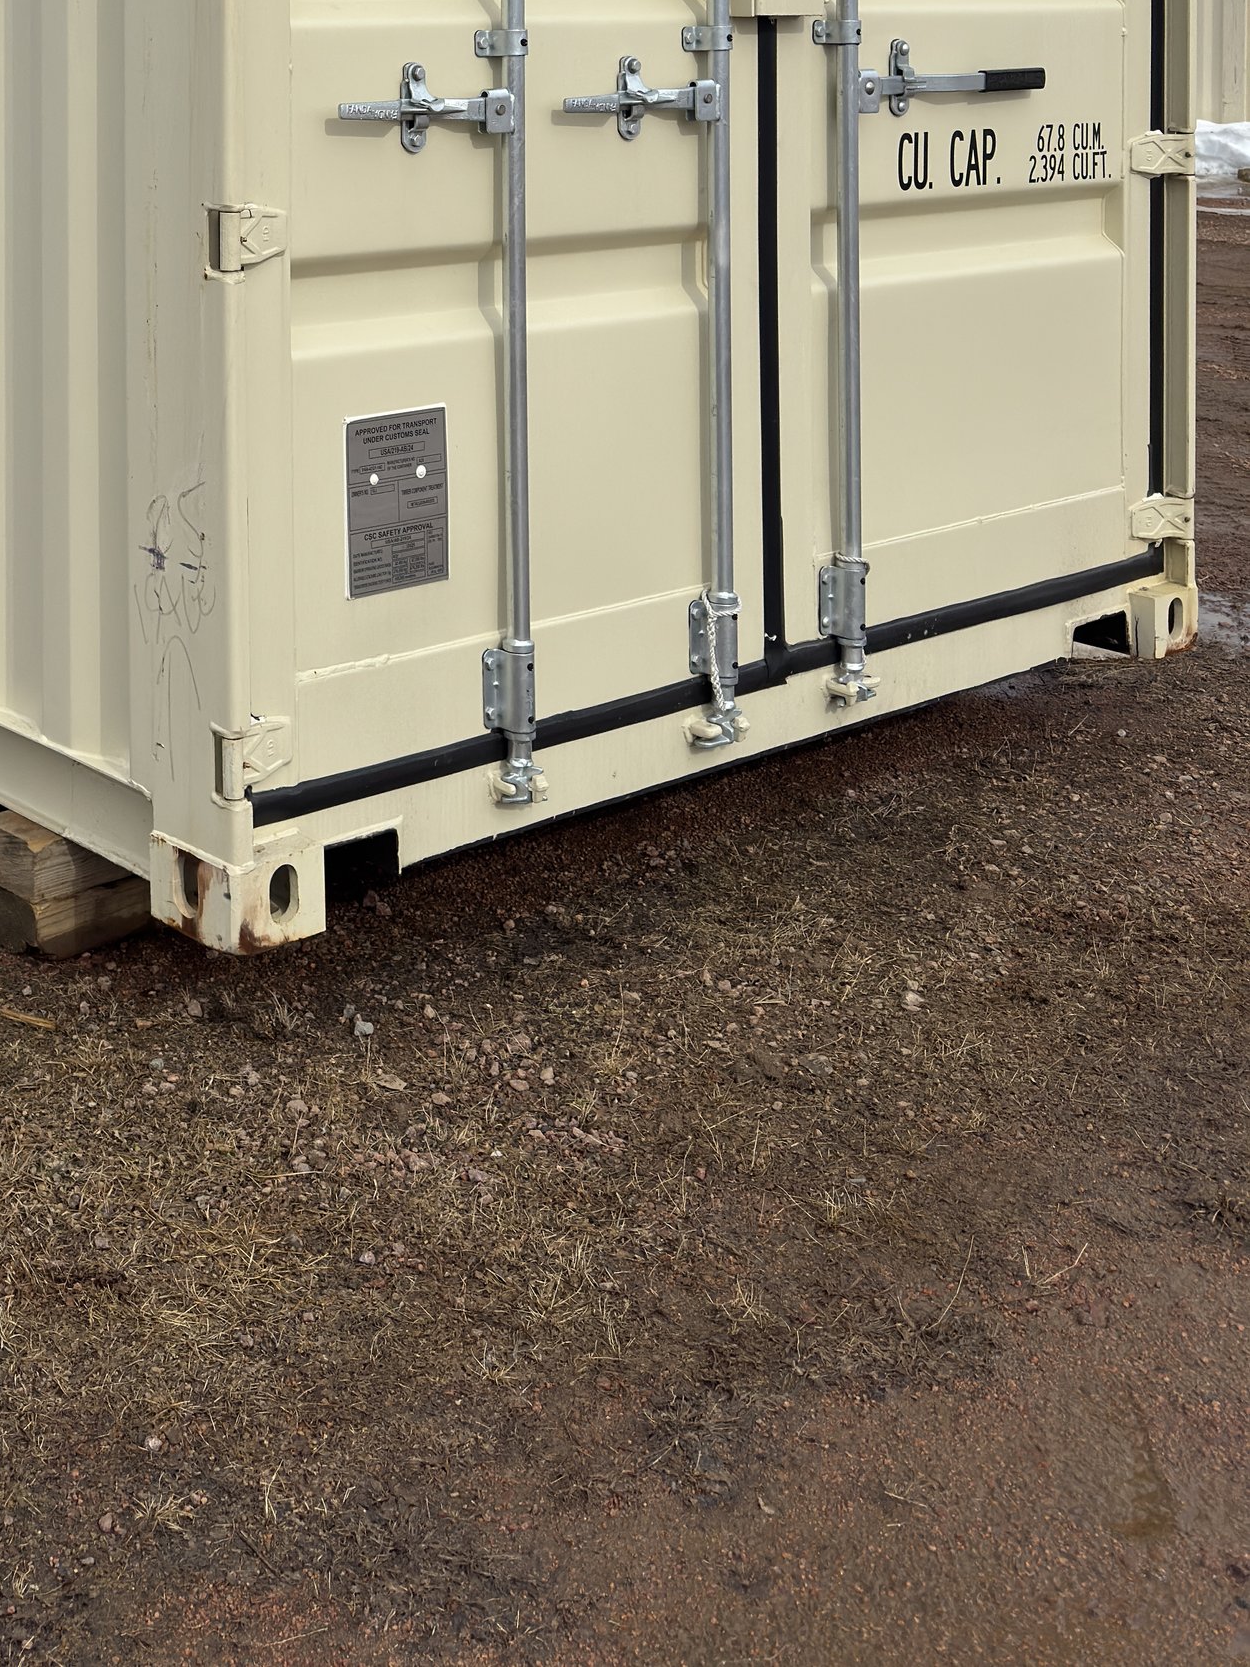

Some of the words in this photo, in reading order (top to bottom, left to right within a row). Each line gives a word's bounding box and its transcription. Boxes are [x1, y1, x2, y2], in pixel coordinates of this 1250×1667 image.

[1036, 123, 1065, 152] 67.8
[897, 131, 933, 191] CU.
[949, 128, 1001, 188] CAP.
[1028, 153, 1065, 184] 2,394
[355, 425, 388, 437] APPROVED
[388, 423, 401, 431] FOR
[402, 417, 438, 429] TRANSPORT
[362, 435, 384, 445] UNDER
[385, 430, 414, 441] CUSTOMS
[414, 428, 430, 436] SEAL
[363, 533, 378, 541] CSC
[378, 528, 402, 539] SAFETY
[402, 522, 434, 533] APPROVAL
